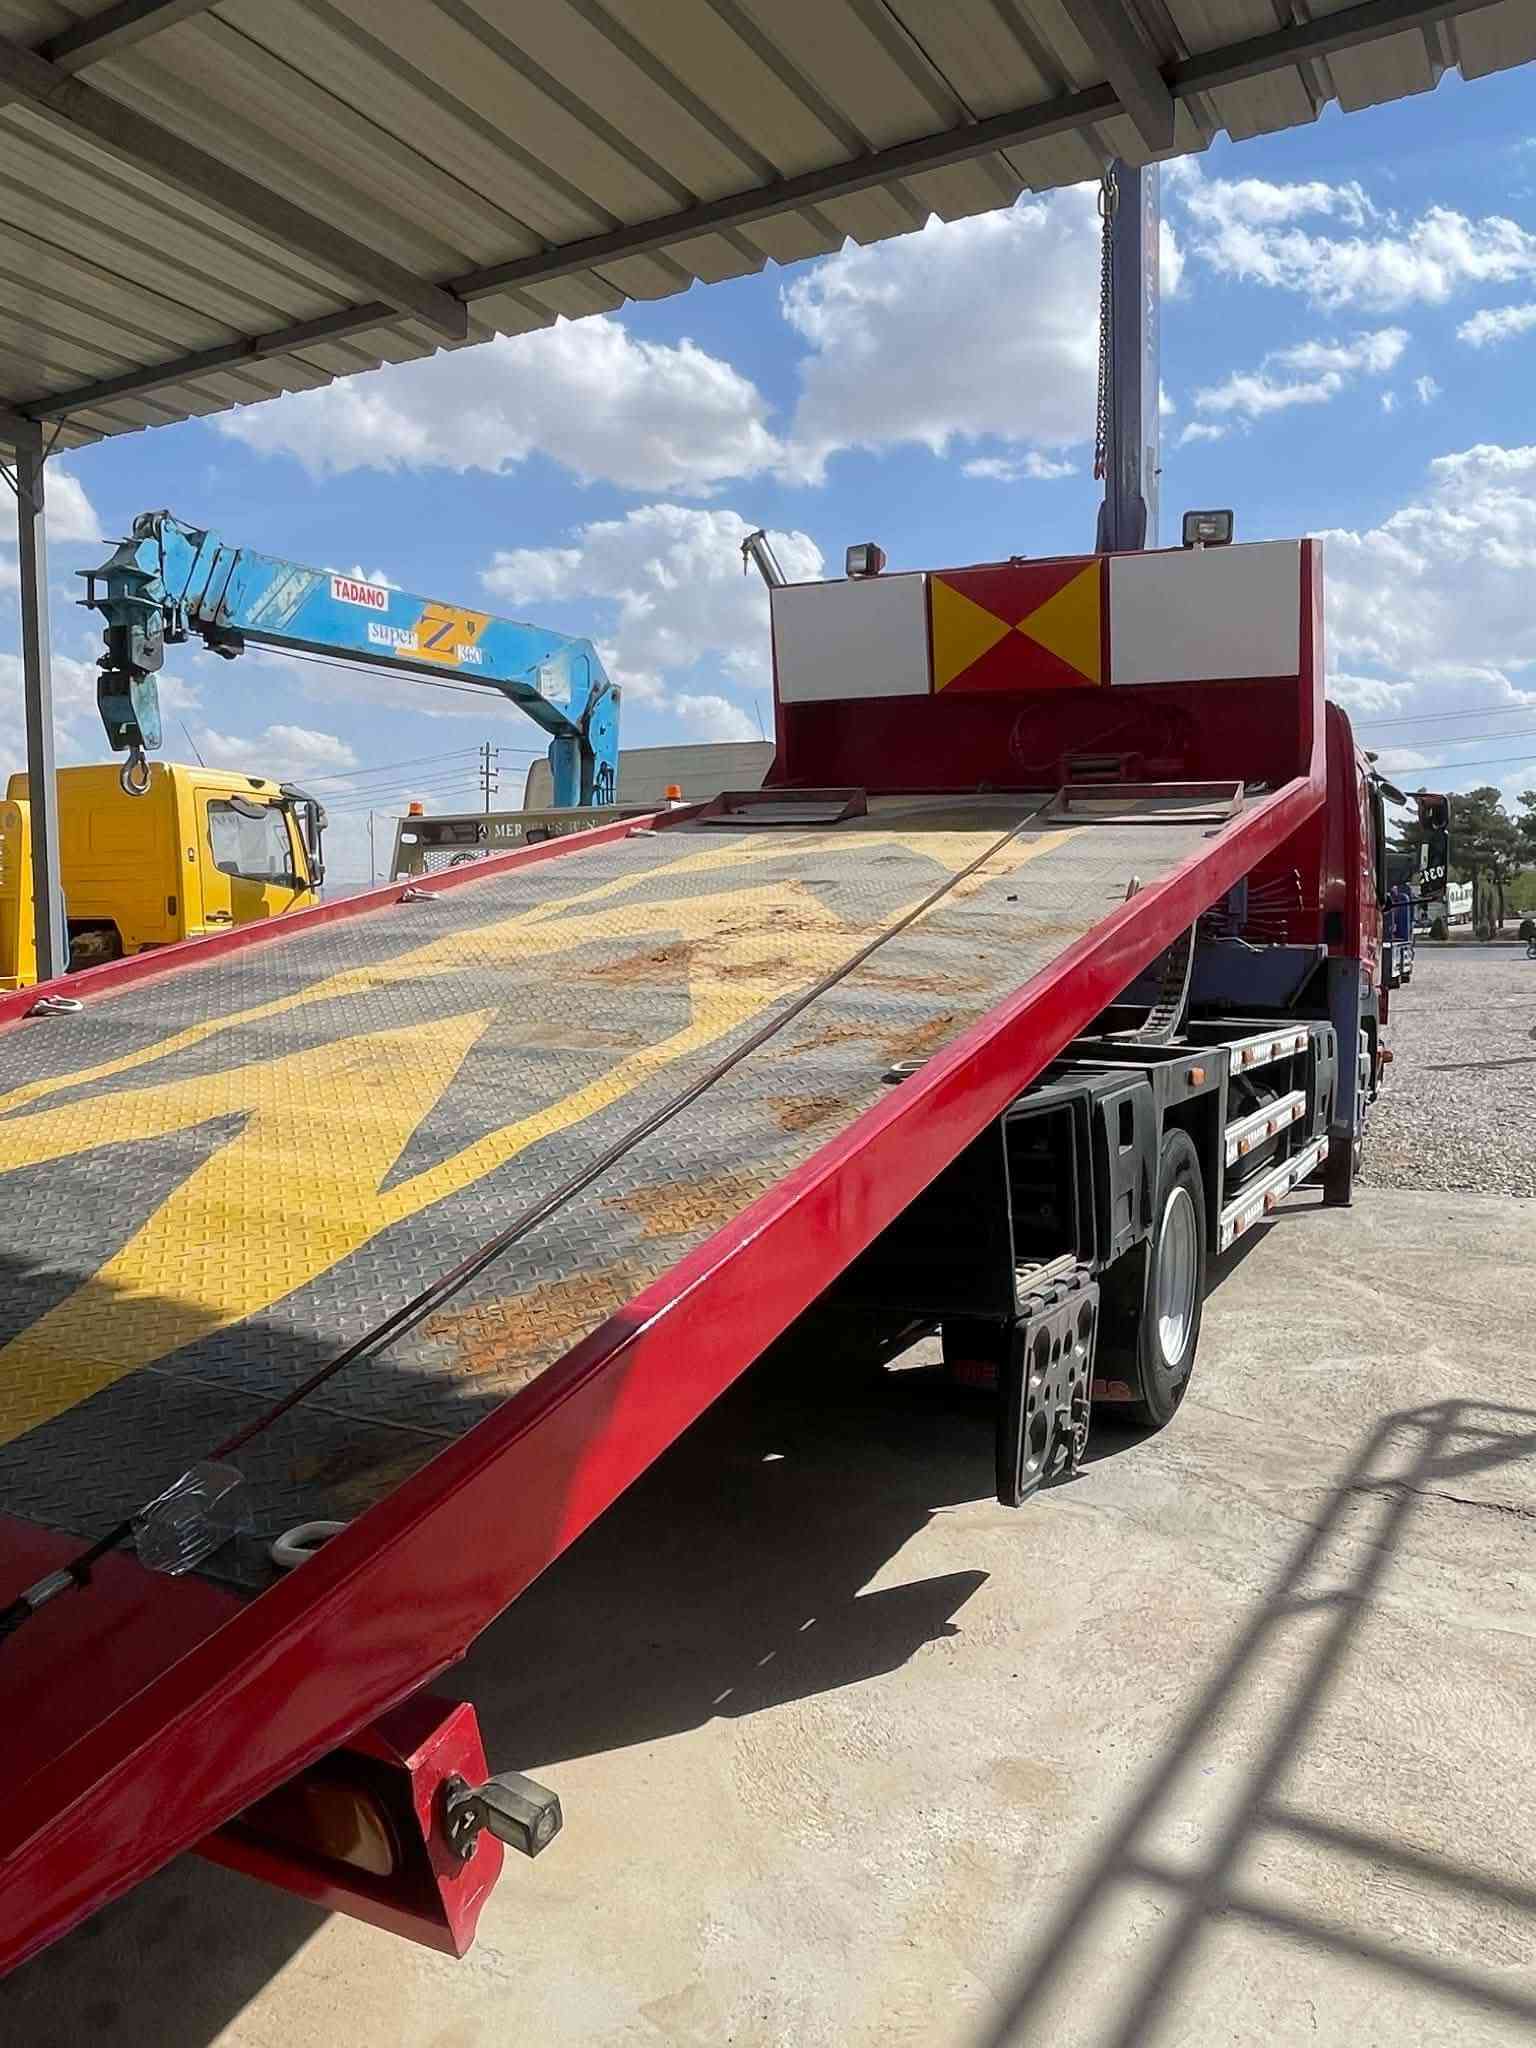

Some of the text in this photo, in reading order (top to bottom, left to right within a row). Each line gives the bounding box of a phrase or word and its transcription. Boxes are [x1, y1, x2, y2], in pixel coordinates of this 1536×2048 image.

[334, 579, 385, 608] TADANO
[371, 623, 417, 646] super
[420, 615, 455, 654] Z
